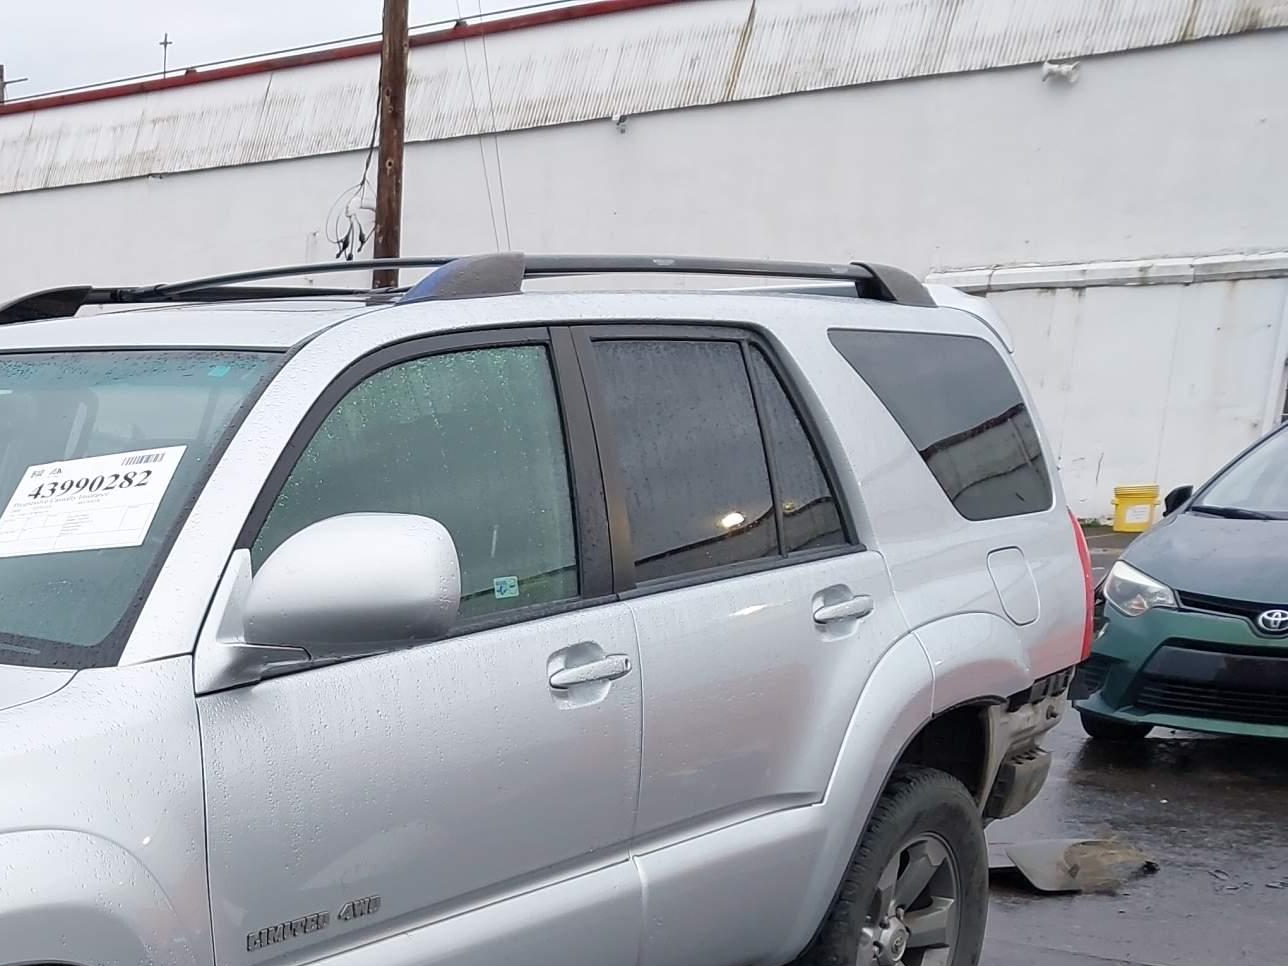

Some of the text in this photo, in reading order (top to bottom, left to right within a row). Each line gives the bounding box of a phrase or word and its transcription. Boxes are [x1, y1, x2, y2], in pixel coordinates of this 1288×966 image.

[28, 470, 153, 499] 43990282
[246, 894, 382, 952] LIMITED 4WD
